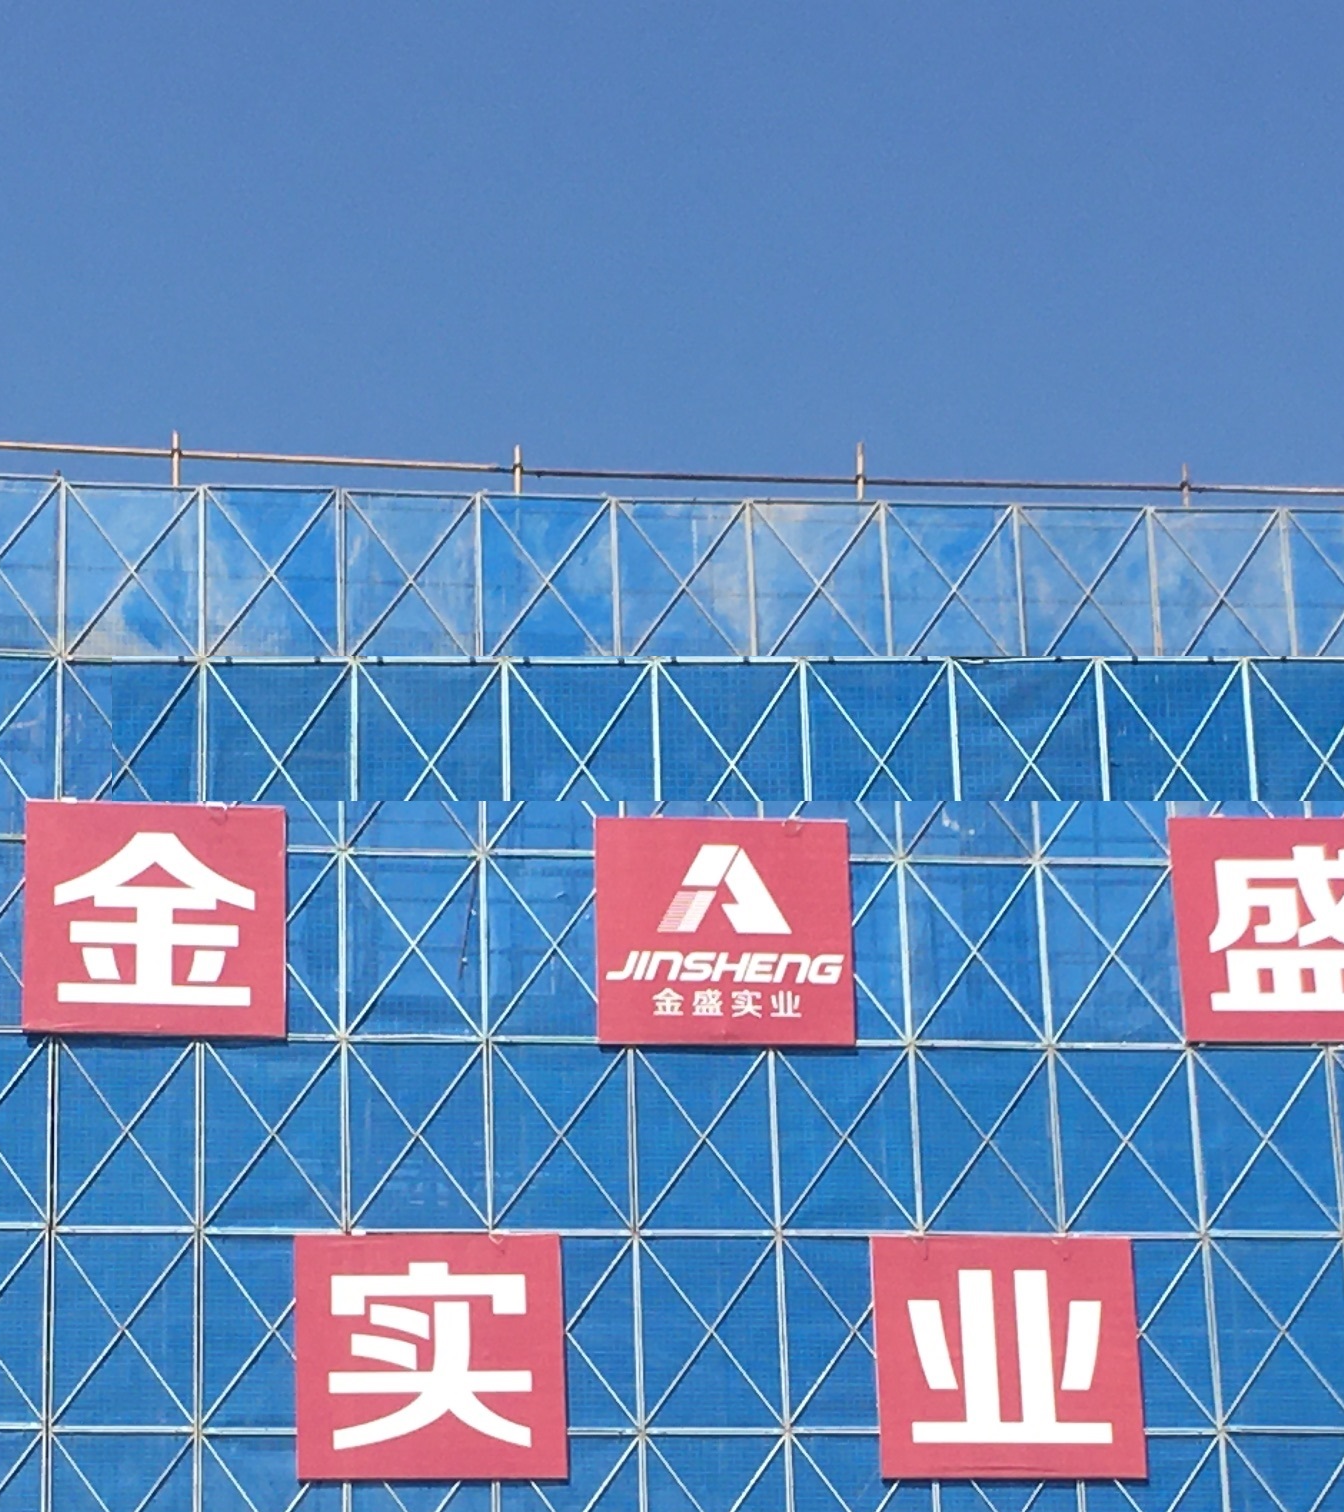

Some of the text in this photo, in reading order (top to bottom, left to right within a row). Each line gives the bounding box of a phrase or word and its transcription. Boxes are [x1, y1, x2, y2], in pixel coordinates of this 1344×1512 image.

[54, 832, 256, 1007] 金
[605, 950, 845, 985] JINSHENG
[652, 987, 802, 1019] 金盛实业
[328, 1261, 533, 1450] 实
[907, 1269, 1113, 1444] 业
